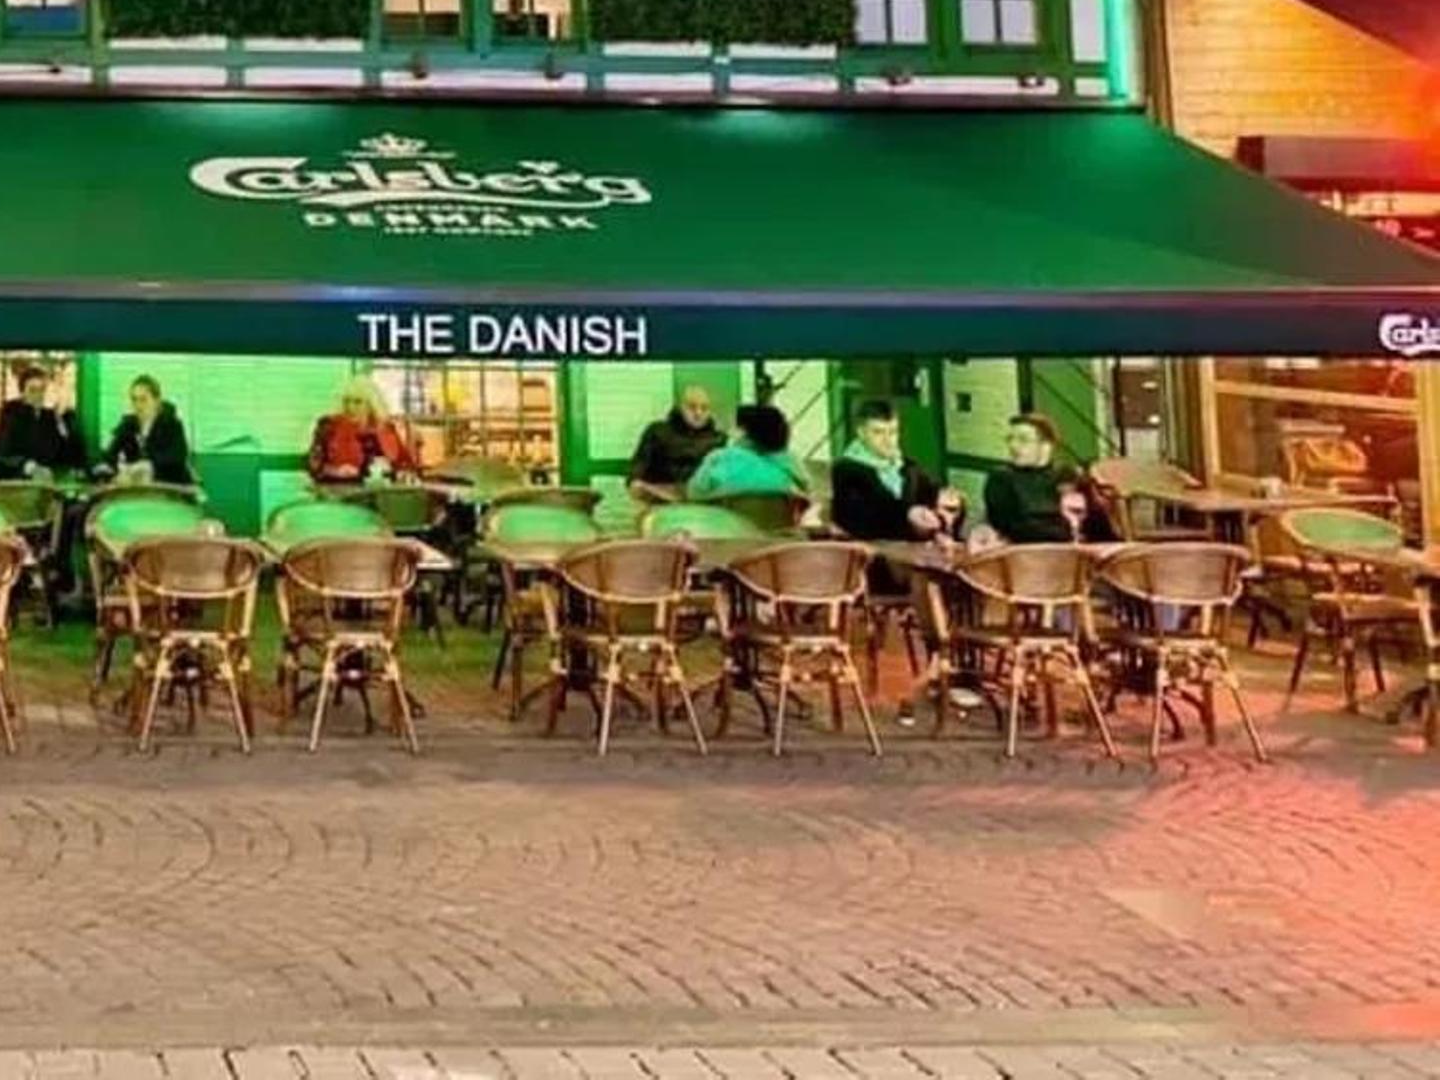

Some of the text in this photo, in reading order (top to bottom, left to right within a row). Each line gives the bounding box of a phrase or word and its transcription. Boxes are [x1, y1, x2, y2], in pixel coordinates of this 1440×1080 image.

[190, 156, 653, 209] Carlsberg
[357, 314, 648, 354] THE DANISH
